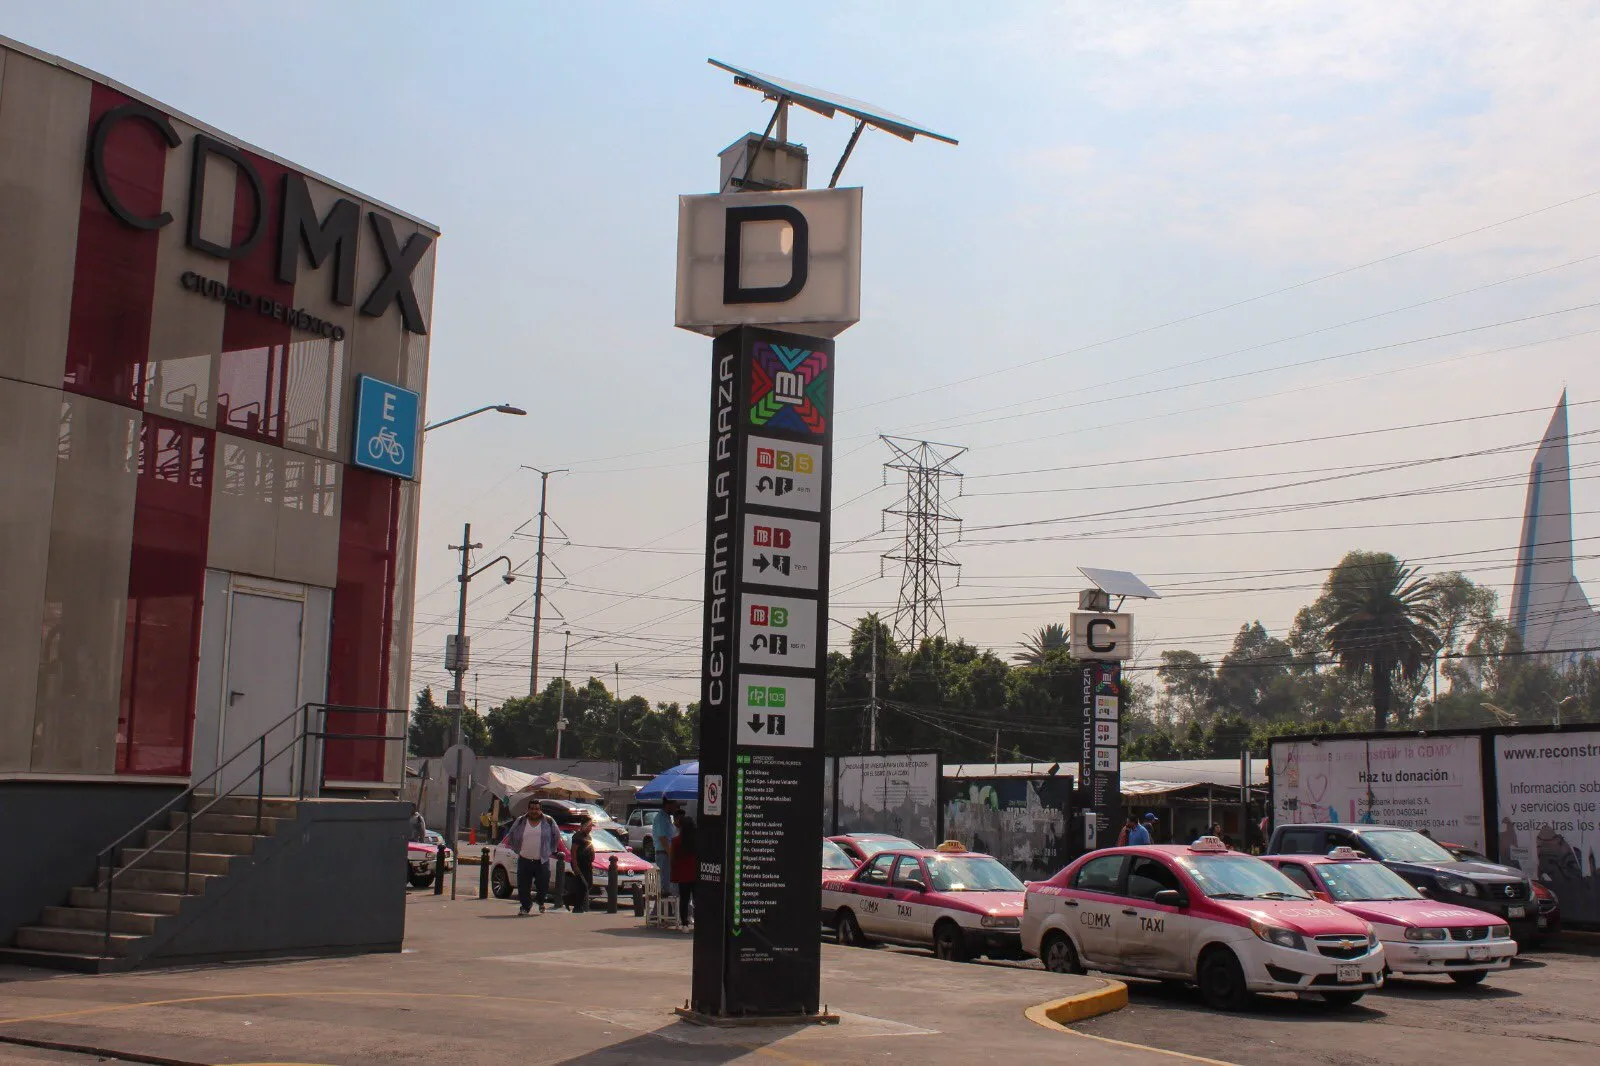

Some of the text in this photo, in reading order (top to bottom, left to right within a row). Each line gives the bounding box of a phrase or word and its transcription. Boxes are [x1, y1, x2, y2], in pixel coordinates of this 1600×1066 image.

[86, 103, 434, 336] CDMX
[723, 205, 808, 304] D
[181, 271, 346, 342] CIUDAD DE MÉXICO
[382, 392, 397, 422] E
[709, 354, 734, 706] CETRAM LA RAZA
[1086, 618, 1116, 652] C
[769, 692, 786, 702] 103
[1082, 668, 1091, 786] CETRAM LA RAZA
[1418, 744, 1452, 758] CDMX
[1504, 744, 1600, 760] www.reconstr
[1359, 769, 1448, 783] Haz tu donación
[1510, 781, 1576, 794] Información
[1511, 804, 1517, 815] y
[1521, 801, 1570, 812] servicios
[1573, 802, 1595, 814] que
[1512, 820, 1548, 831] realiza
[1552, 820, 1574, 831] tras
[1578, 820, 1594, 831] los
[860, 899, 878, 913] CDMX
[897, 904, 912, 917] TAXI
[1080, 911, 1110, 928] CDMX
[1140, 917, 1164, 933] TAXI
